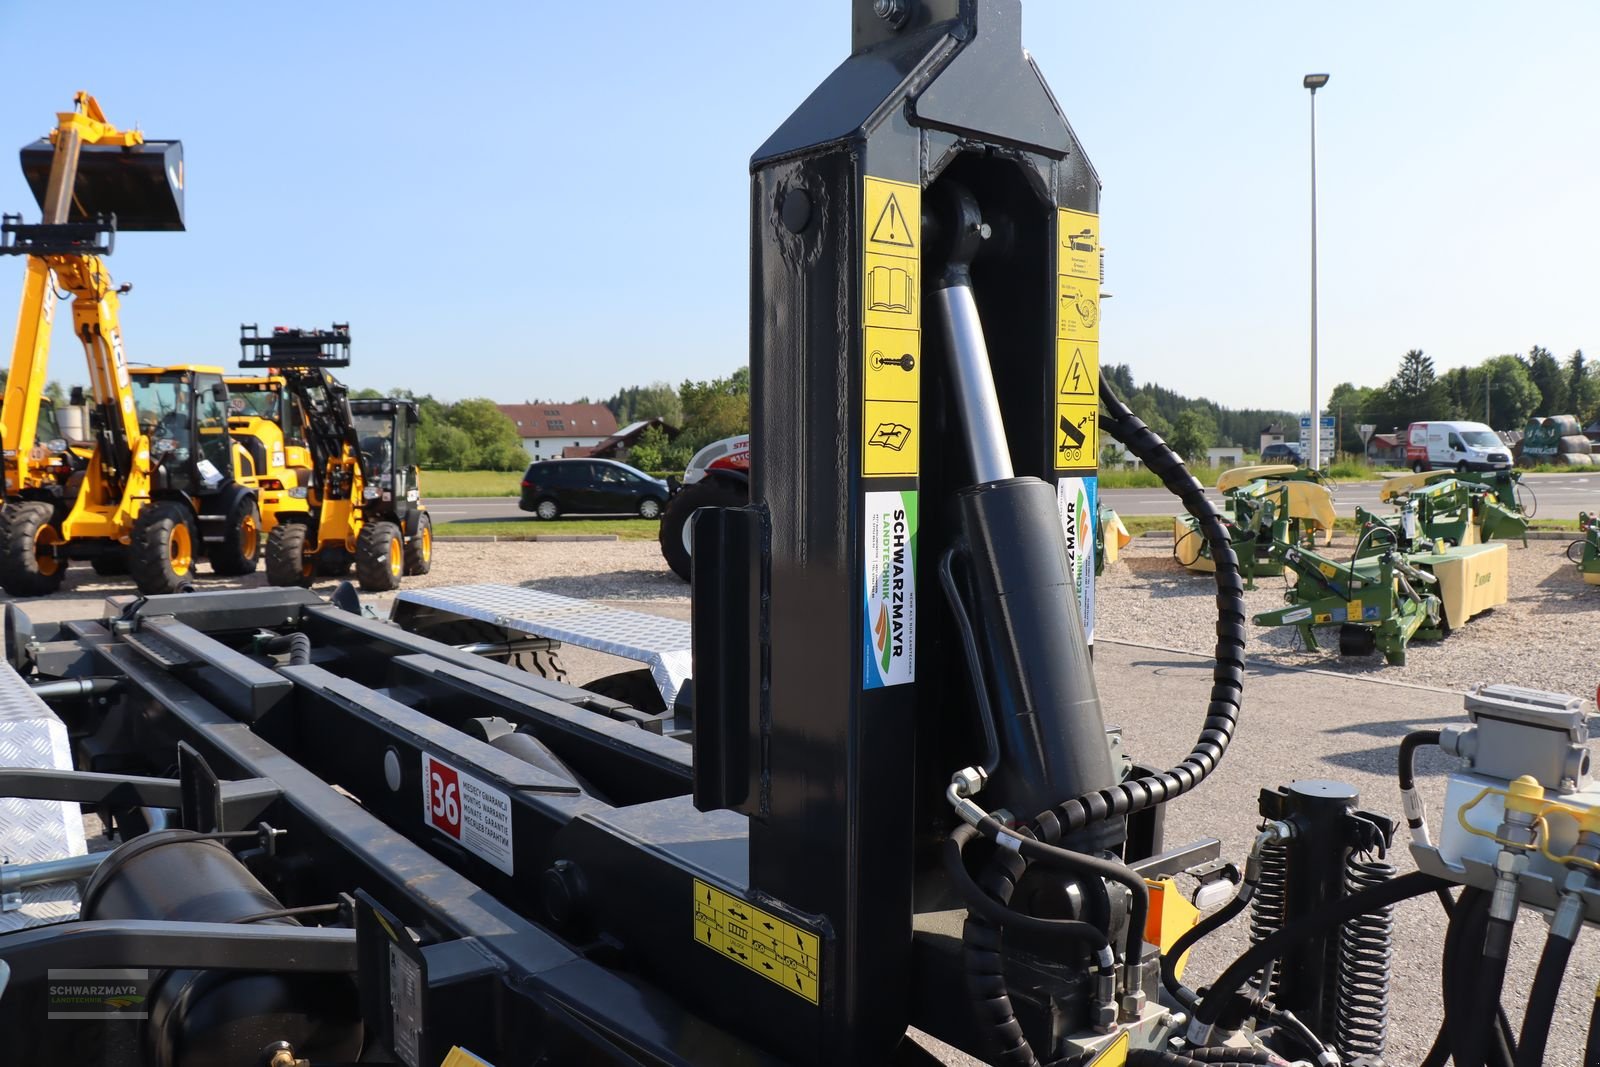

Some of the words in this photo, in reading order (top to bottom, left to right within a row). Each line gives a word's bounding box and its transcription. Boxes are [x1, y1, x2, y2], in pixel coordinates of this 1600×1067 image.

[882, 513, 891, 600] LANDTECHNIK
[892, 509, 905, 657] SCHWARZMAYR
[431, 771, 459, 826] 36
[482, 802, 509, 823] WARRANTY
[484, 815, 509, 836] GARANTIE
